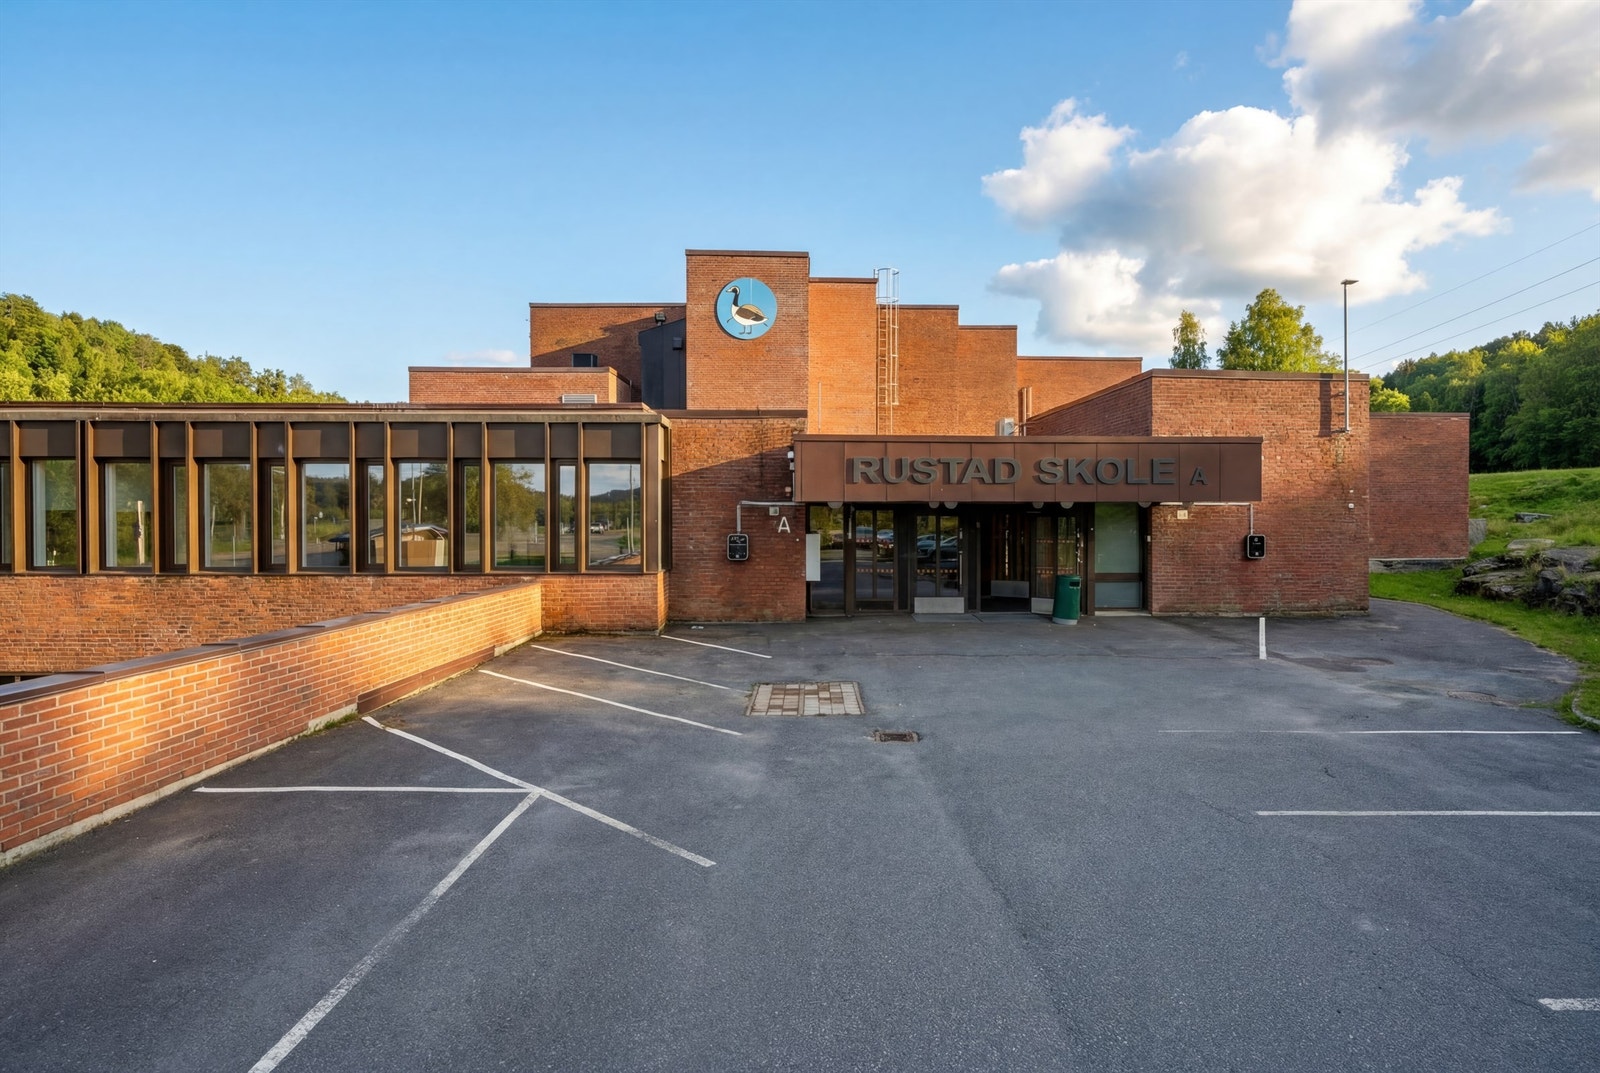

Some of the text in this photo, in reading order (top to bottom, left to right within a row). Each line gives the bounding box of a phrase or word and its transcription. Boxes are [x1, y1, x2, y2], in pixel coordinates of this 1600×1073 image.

[852, 456, 1208, 485] RUSTAD SKOLE A
[778, 516, 791, 533] A
